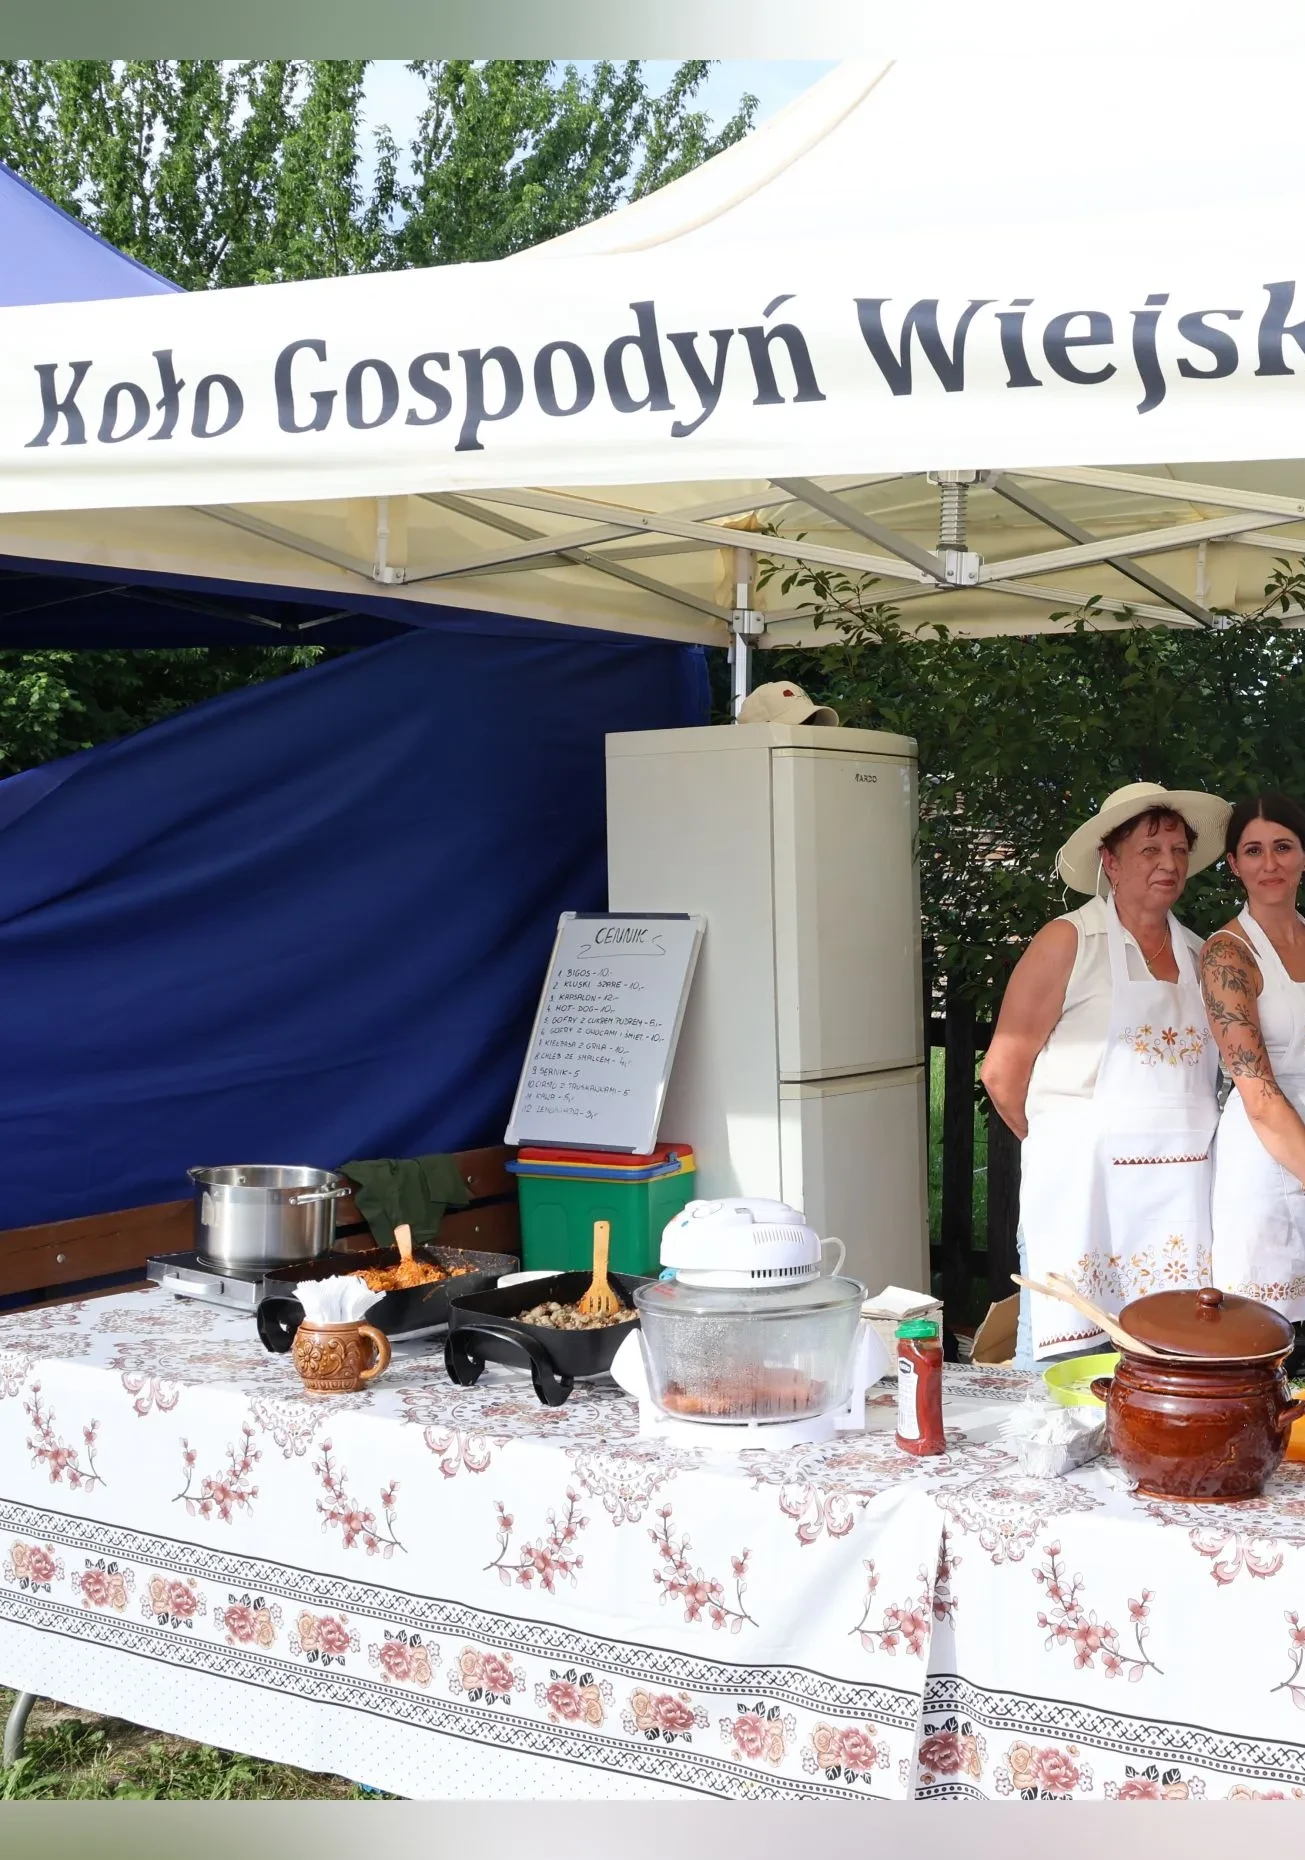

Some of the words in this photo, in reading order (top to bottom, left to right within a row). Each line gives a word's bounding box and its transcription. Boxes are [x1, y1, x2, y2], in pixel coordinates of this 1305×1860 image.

[25, 349, 244, 449] Koło
[275, 293, 827, 453] Gospodyń
[595, 927, 648, 944] CENNIK
[567, 968, 591, 977] BIGOS
